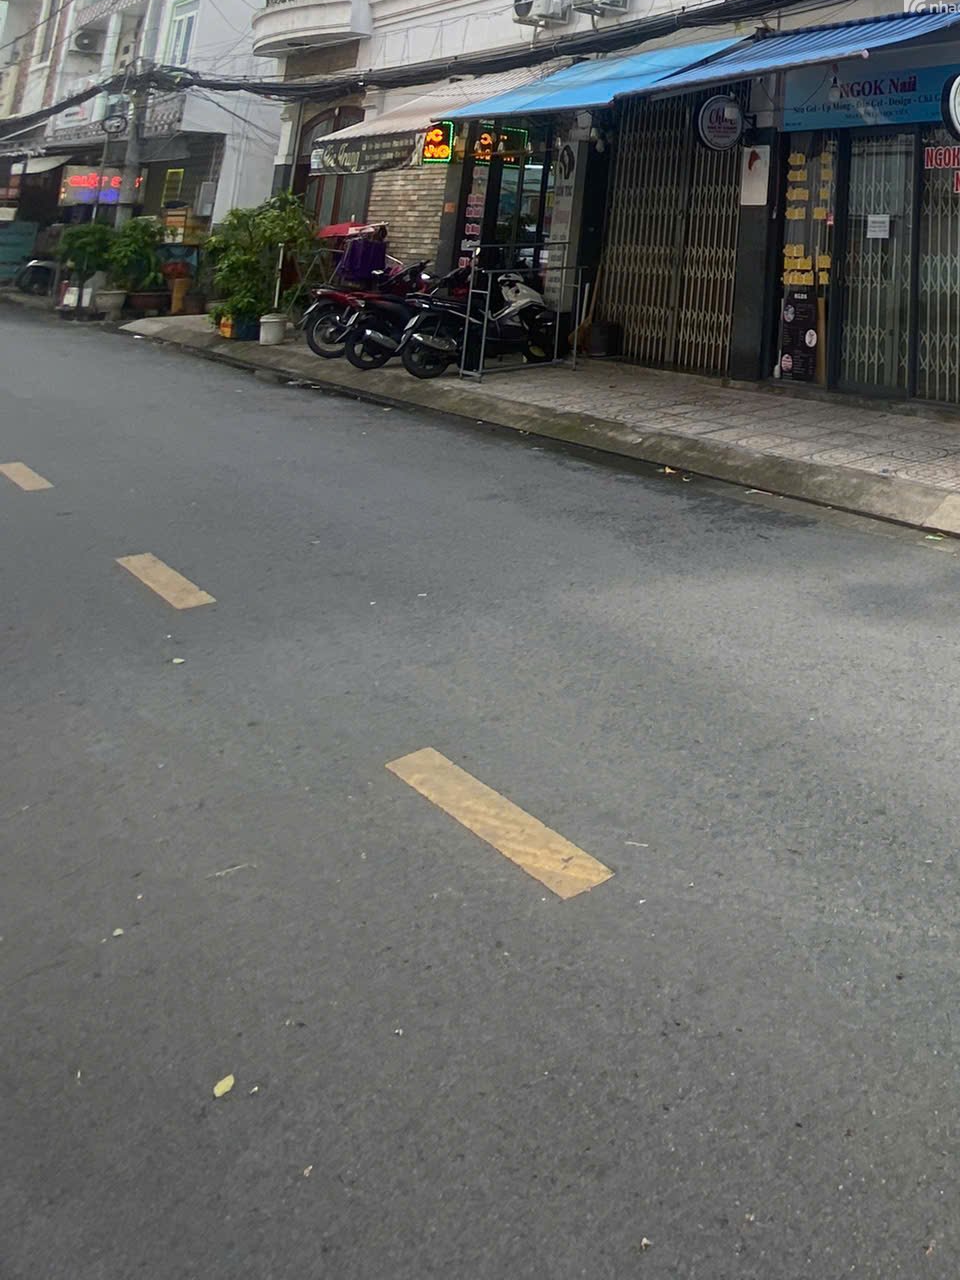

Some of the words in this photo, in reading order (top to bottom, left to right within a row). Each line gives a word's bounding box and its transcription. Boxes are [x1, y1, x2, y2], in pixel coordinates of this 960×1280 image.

[840, 79, 884, 98] NGOK
[888, 76, 917, 94] Nail
[925, 147, 960, 169] NGOK
